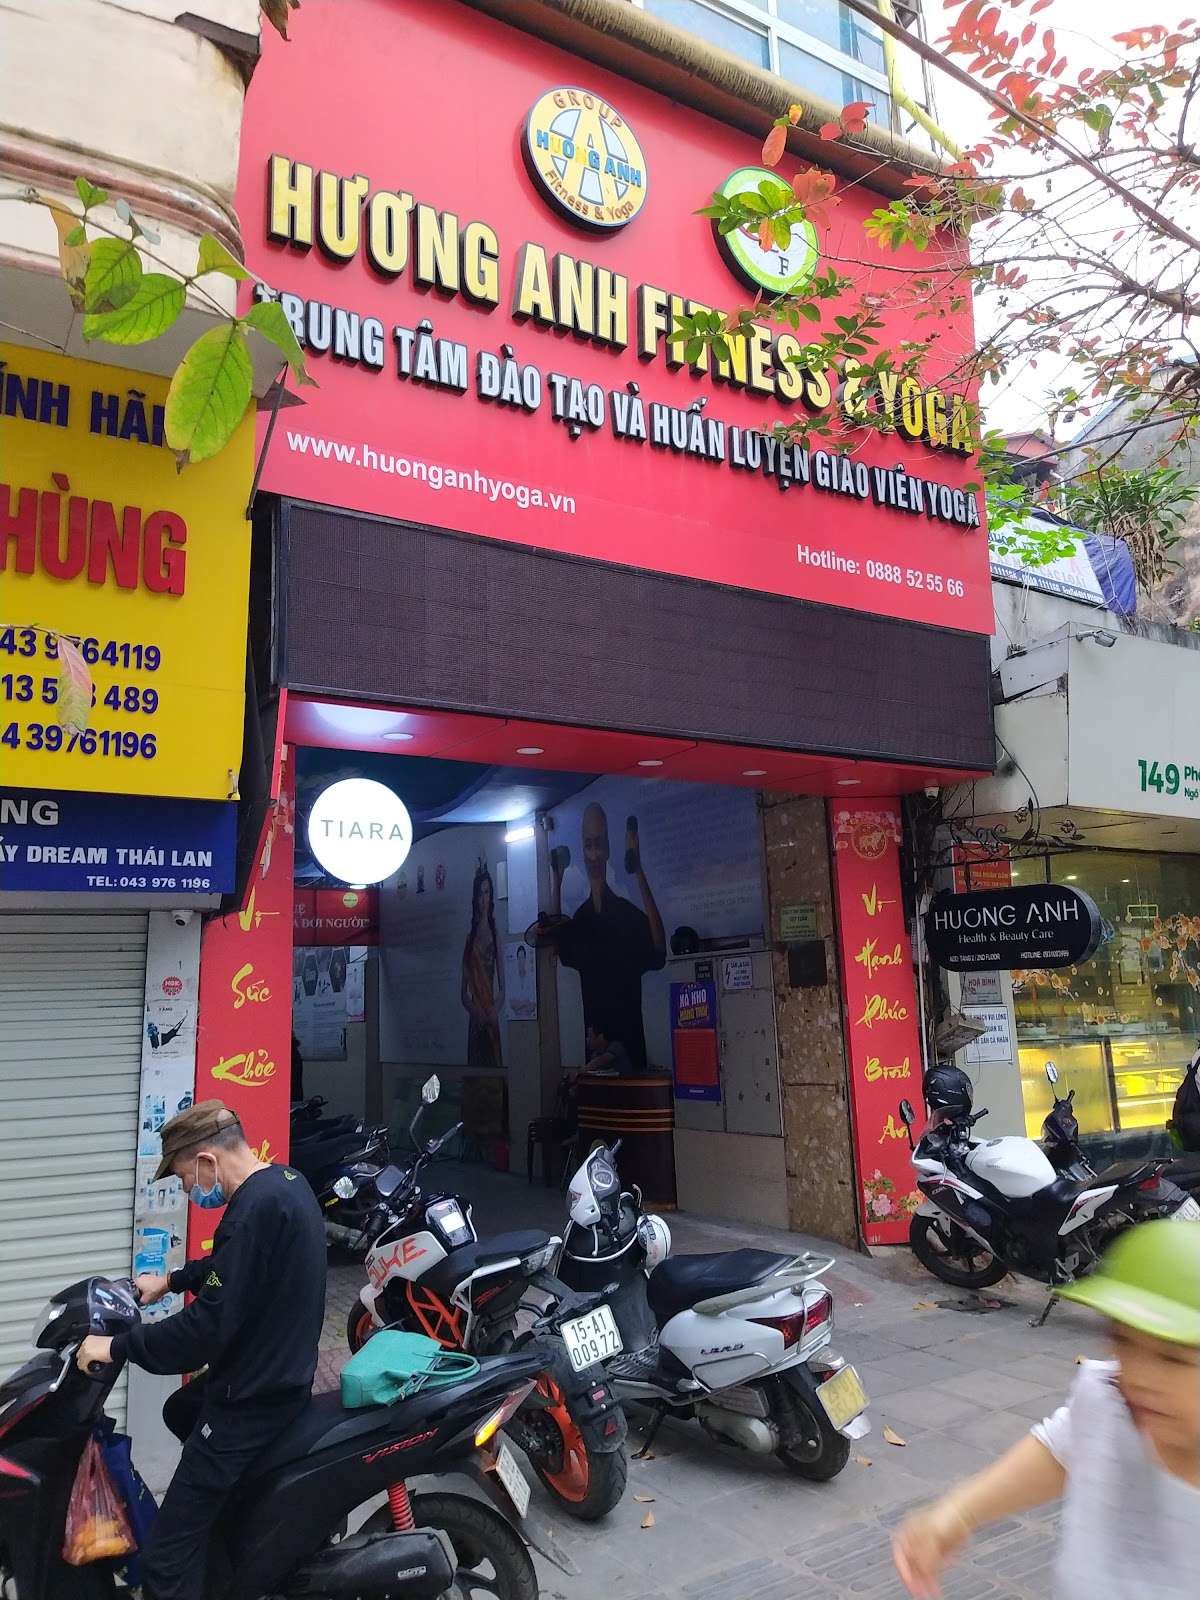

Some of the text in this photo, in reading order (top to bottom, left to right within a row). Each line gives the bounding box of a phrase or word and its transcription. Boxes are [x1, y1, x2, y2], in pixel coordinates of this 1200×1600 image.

[553, 90, 623, 128] GROUP
[536, 129, 642, 188] HUONG ANH
[594, 206, 604, 220] &
[606, 200, 634, 220] Yoga
[268, 153, 500, 308] HƯƠNG
[514, 241, 628, 350] ANH
[638, 283, 832, 411] FITNESS
[877, 371, 975, 457] YOGA
[393, 318, 468, 393] TÂM
[477, 343, 541, 411] ĐÀO
[548, 372, 605, 439] TẠO
[609, 382, 647, 443] VÀ
[650, 397, 725, 463] HUẤN
[870, 463, 924, 514] VIÊN
[925, 481, 981, 528] YOGA
[286, 430, 576, 515] www.huonganhyoga.vn
[0, 472, 187, 596] HÙNG
[797, 544, 964, 598] Hotline: 0888 52 55 66
[1, 674, 33, 702] 13
[104, 685, 158, 714] 489
[1, 722, 20, 750] 4
[1138, 759, 1180, 795] 149
[0, 799, 59, 826] NG
[320, 819, 404, 841] TIARA
[27, 845, 108, 865] DREAM
[116, 844, 164, 866] THÁI
[171, 850, 213, 867] LAN
[120, 877, 147, 888] 043
[151, 878, 176, 888] 976
[181, 878, 210, 889] 1196
[1026, 899, 1079, 924] ANH
[958, 929, 1054, 944] Health & Beauty Care
[232, 963, 273, 1009] Sức
[368, 1237, 428, 1290] DUKE
[571, 1312, 608, 1344] 15-A1
[572, 1331, 620, 1367] 009.72
[362, 1428, 439, 1464] VISION
